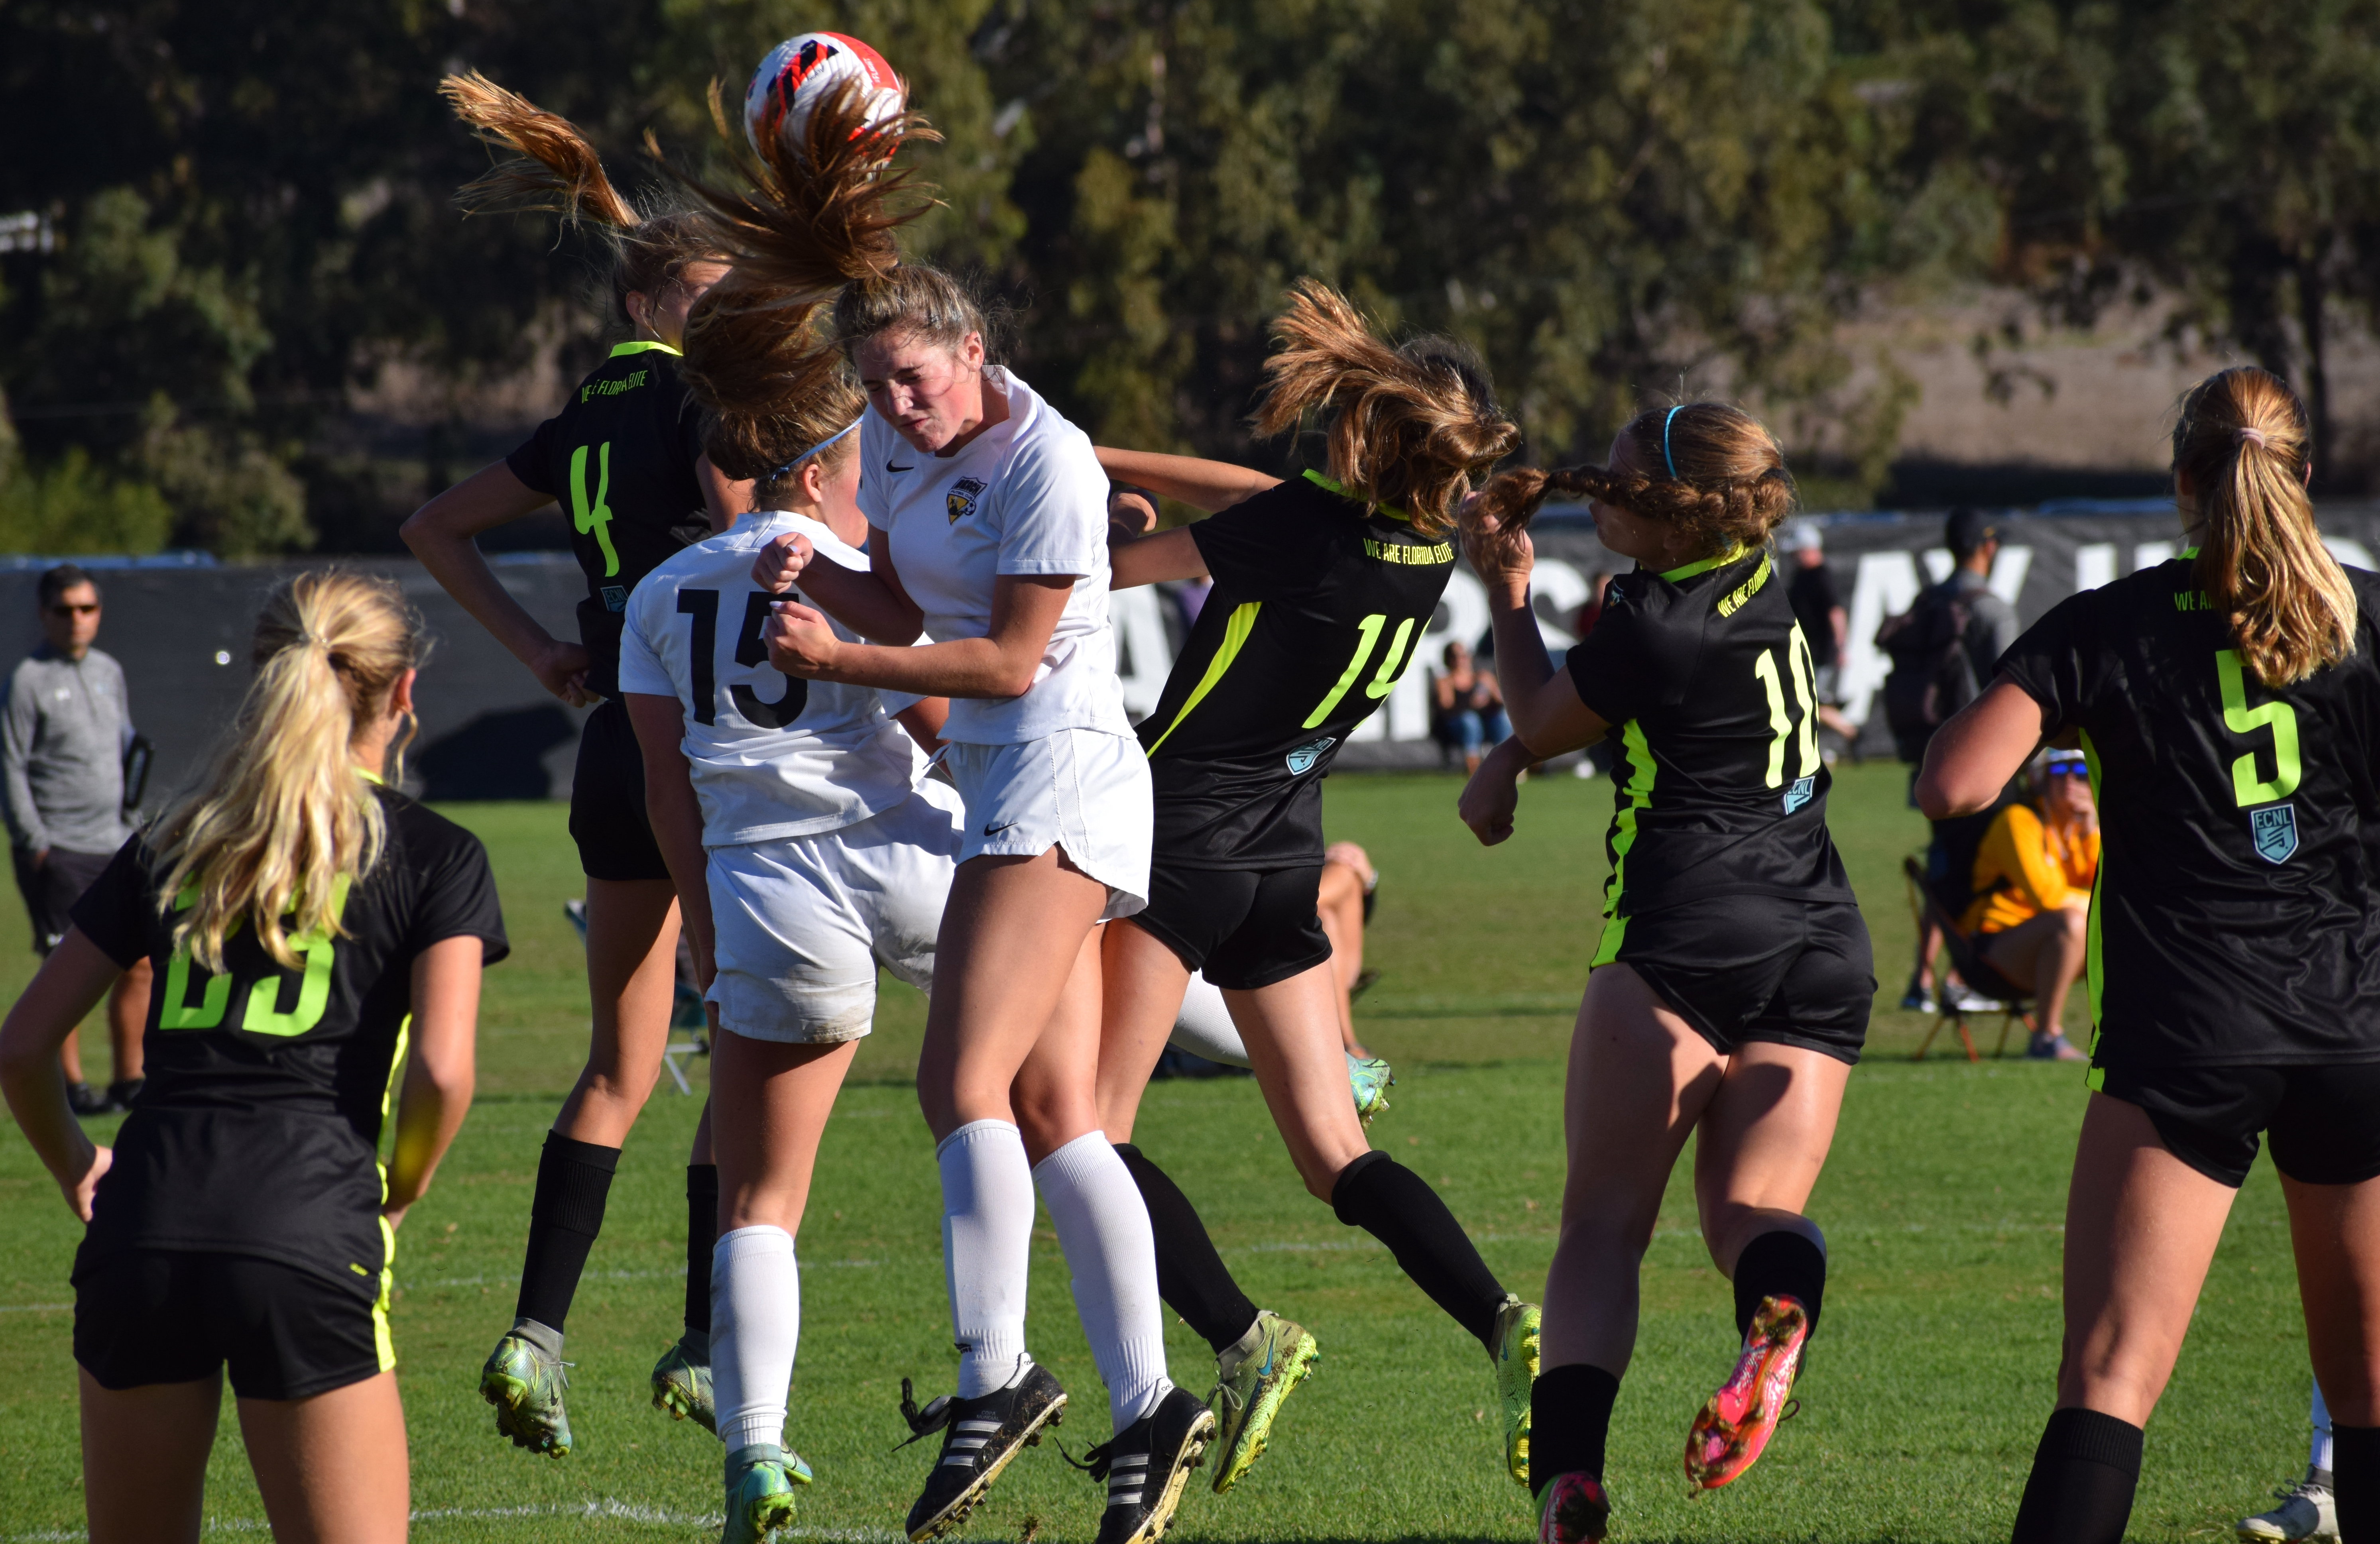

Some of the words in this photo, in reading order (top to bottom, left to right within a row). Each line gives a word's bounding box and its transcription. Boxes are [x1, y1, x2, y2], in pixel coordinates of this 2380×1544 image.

[628, 370, 648, 389] ELITE
[570, 441, 619, 577] 4
[1363, 538, 1381, 559] WE
[1383, 543, 1400, 563] ARE
[1403, 546, 1435, 565] FLORIDA
[1434, 542, 1454, 564] ELITE
[604, 589, 628, 603] ECNL
[1718, 594, 1737, 618] WE
[1733, 583, 1748, 608] ARE
[1748, 561, 1768, 597] FLORIDA
[2174, 590, 2195, 611] WE
[677, 589, 808, 729] 15
[1302, 614, 1431, 731] 14
[1755, 617, 1820, 788] 10
[2215, 649, 2301, 807] 5
[2255, 809, 2291, 828] ECNL
